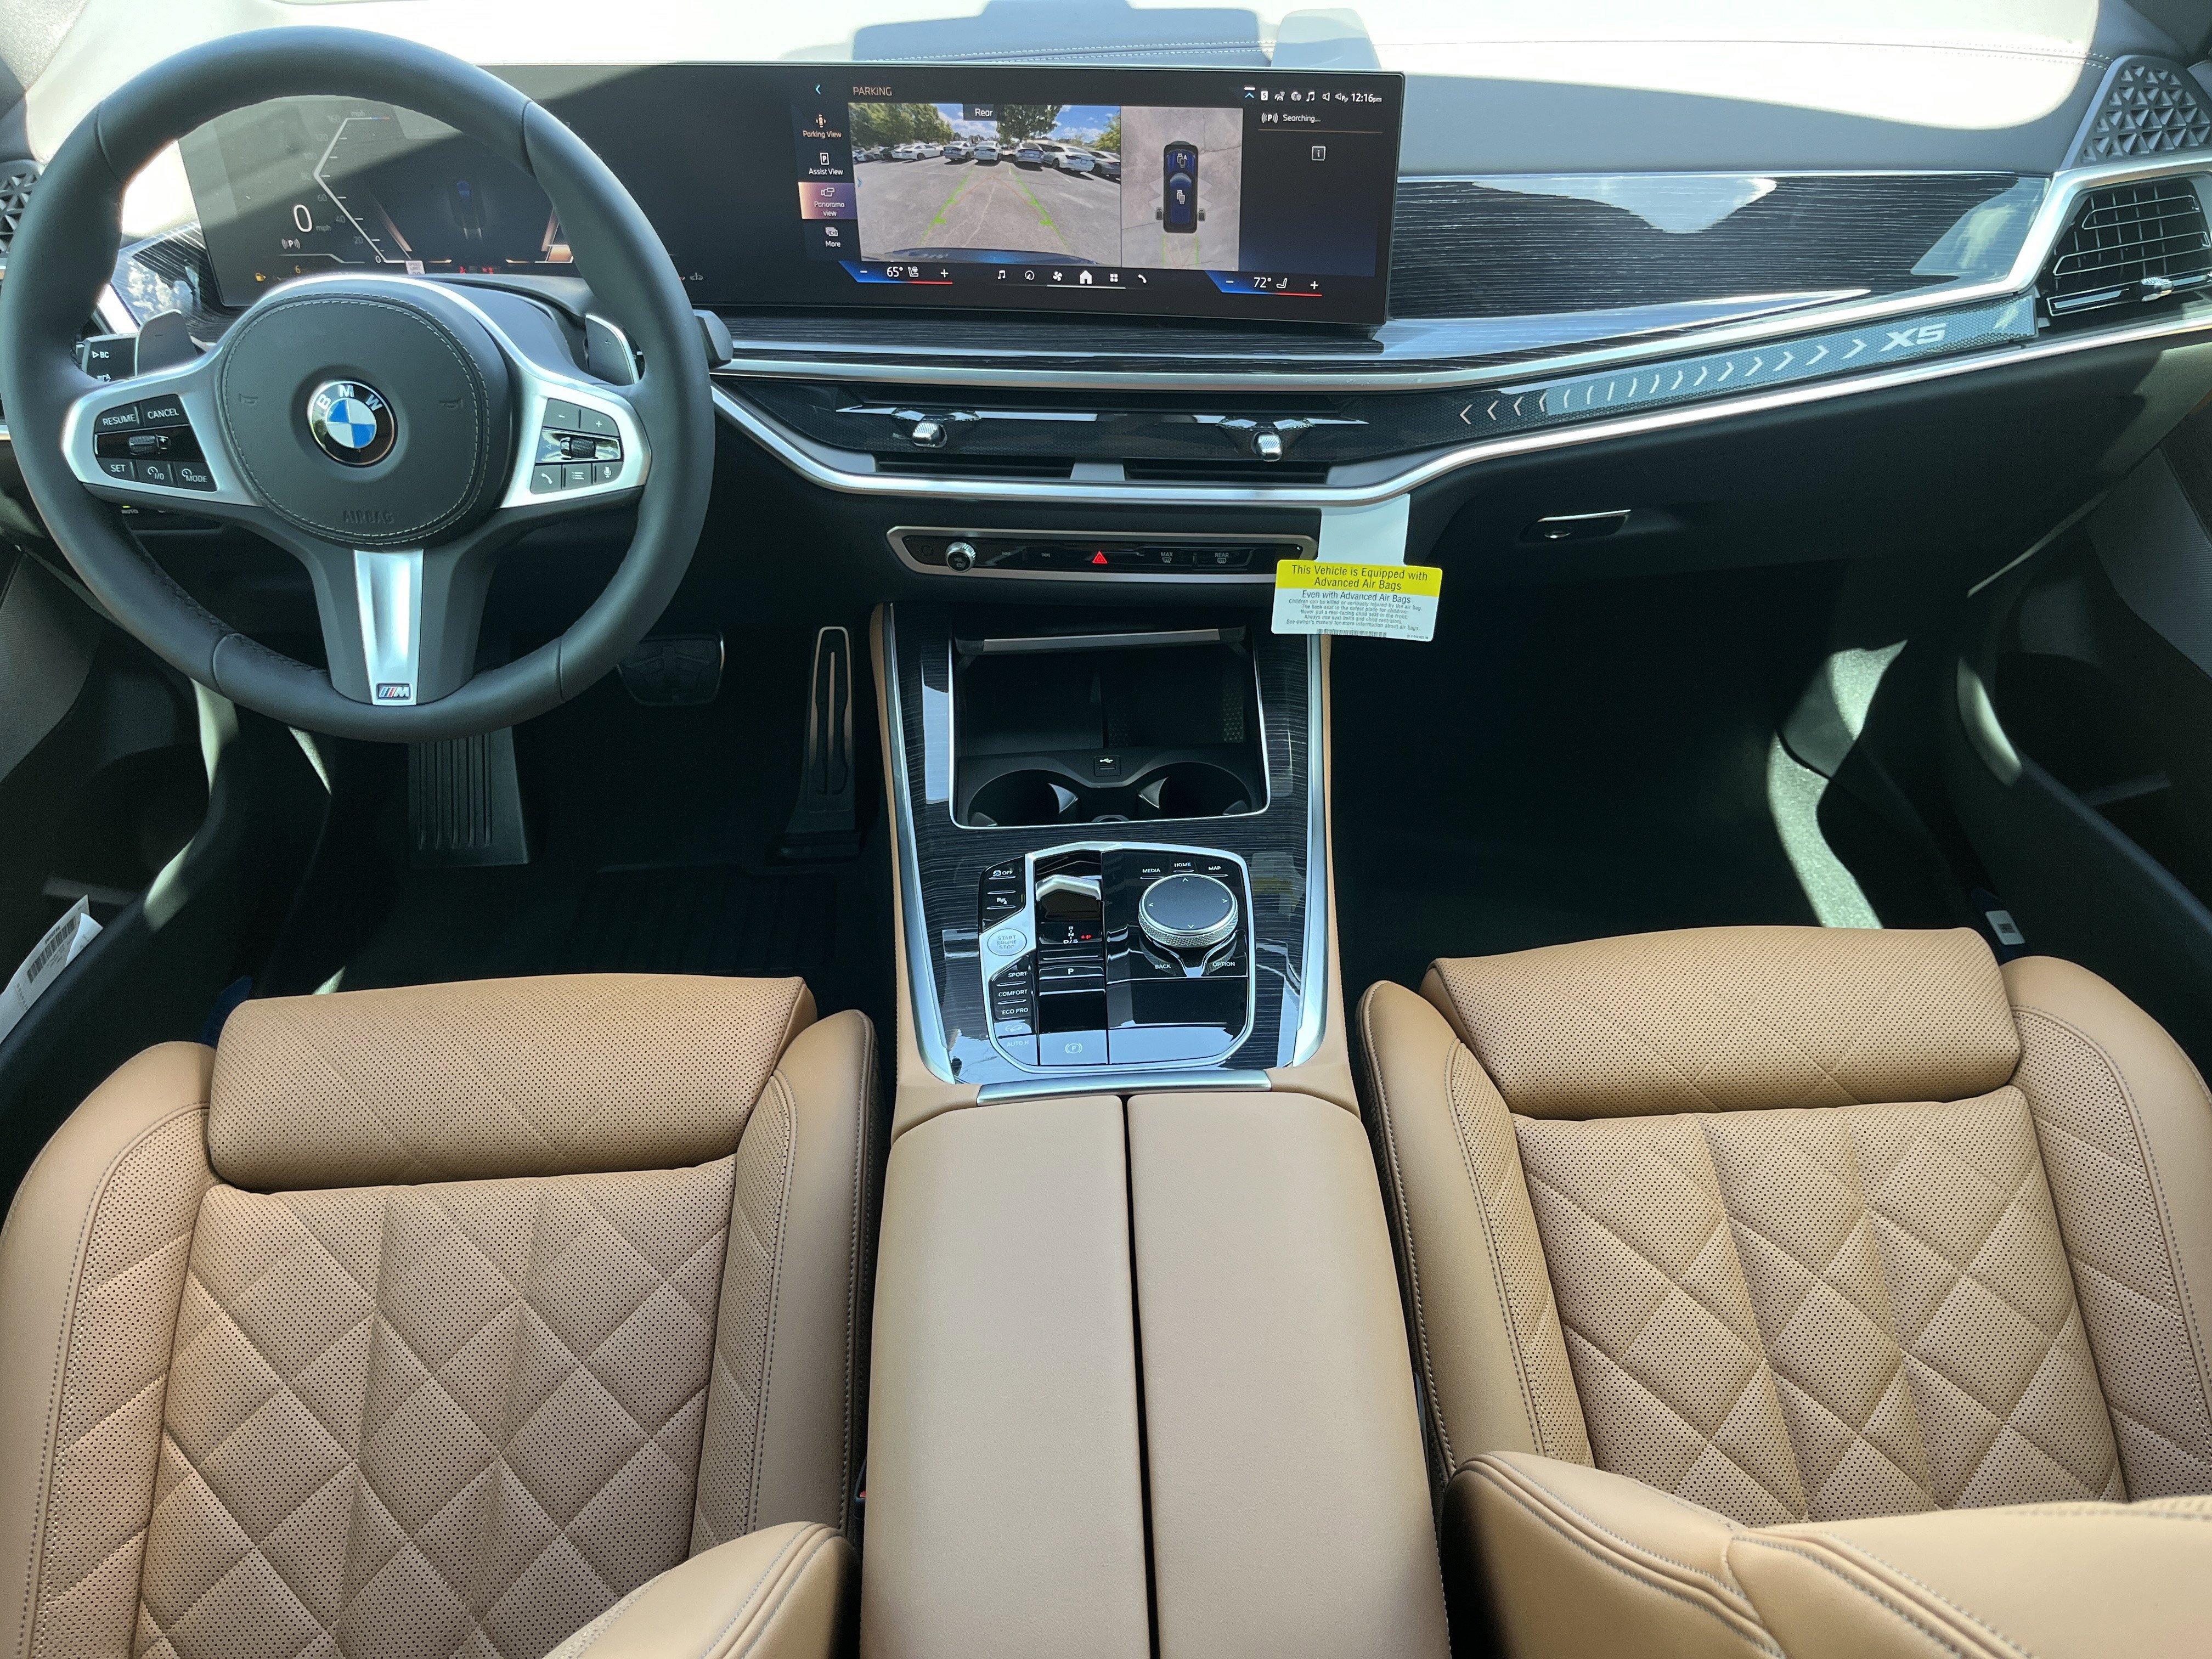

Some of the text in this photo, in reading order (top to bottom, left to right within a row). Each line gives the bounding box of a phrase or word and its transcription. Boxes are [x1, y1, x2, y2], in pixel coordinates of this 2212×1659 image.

[853, 87, 893, 96] PARKING
[974, 108, 994, 117] Rear
[803, 130, 826, 139] Parking
[317, 194, 328, 202] 60
[293, 204, 313, 233] 0
[335, 215, 346, 223] 40
[315, 224, 332, 233] mph
[353, 236, 364, 245] 20
[375, 255, 381, 263] 0
[1878, 323, 1947, 352] X5
[316, 384, 383, 411] BMW
[102, 408, 179, 426] RESUME CANCEL
[110, 464, 126, 472] SET
[185, 475, 208, 483] MODE
[342, 510, 394, 524] AIRBAG
[1292, 565, 1427, 581] This Vehicle is Equipped with
[1314, 577, 1402, 591] Advanced Air Bags
[1302, 590, 1411, 605] Even with Advanced Air Bags
